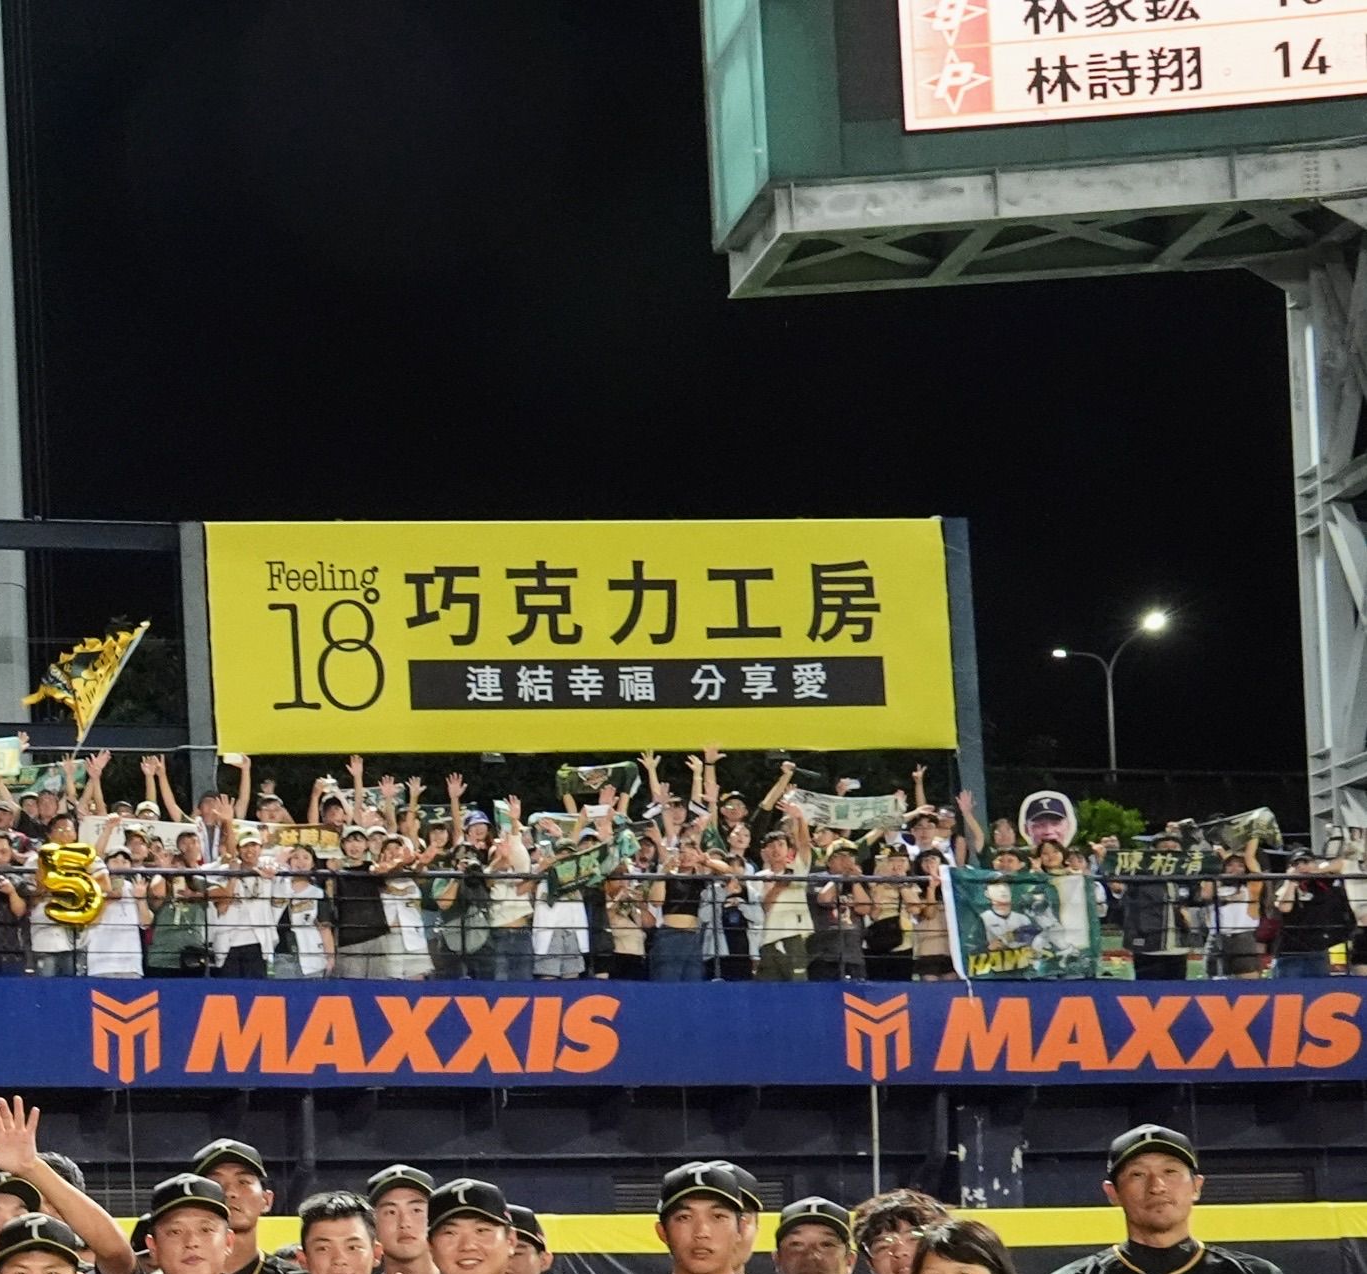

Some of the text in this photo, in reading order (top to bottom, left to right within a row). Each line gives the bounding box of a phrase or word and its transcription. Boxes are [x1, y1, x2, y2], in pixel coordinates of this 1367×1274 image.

[1027, 46, 1203, 104] 林詩翔
[1274, 38, 1332, 79] 14
[265, 560, 380, 605] Feeling
[404, 559, 883, 647] 巧克力工房
[267, 599, 386, 712] 18
[466, 661, 829, 703] 連結幸福 分享愛
[39, 842, 104, 926] 5
[187, 997, 620, 1074] MAXXIS
[934, 992, 1363, 1072] MAXXIS
